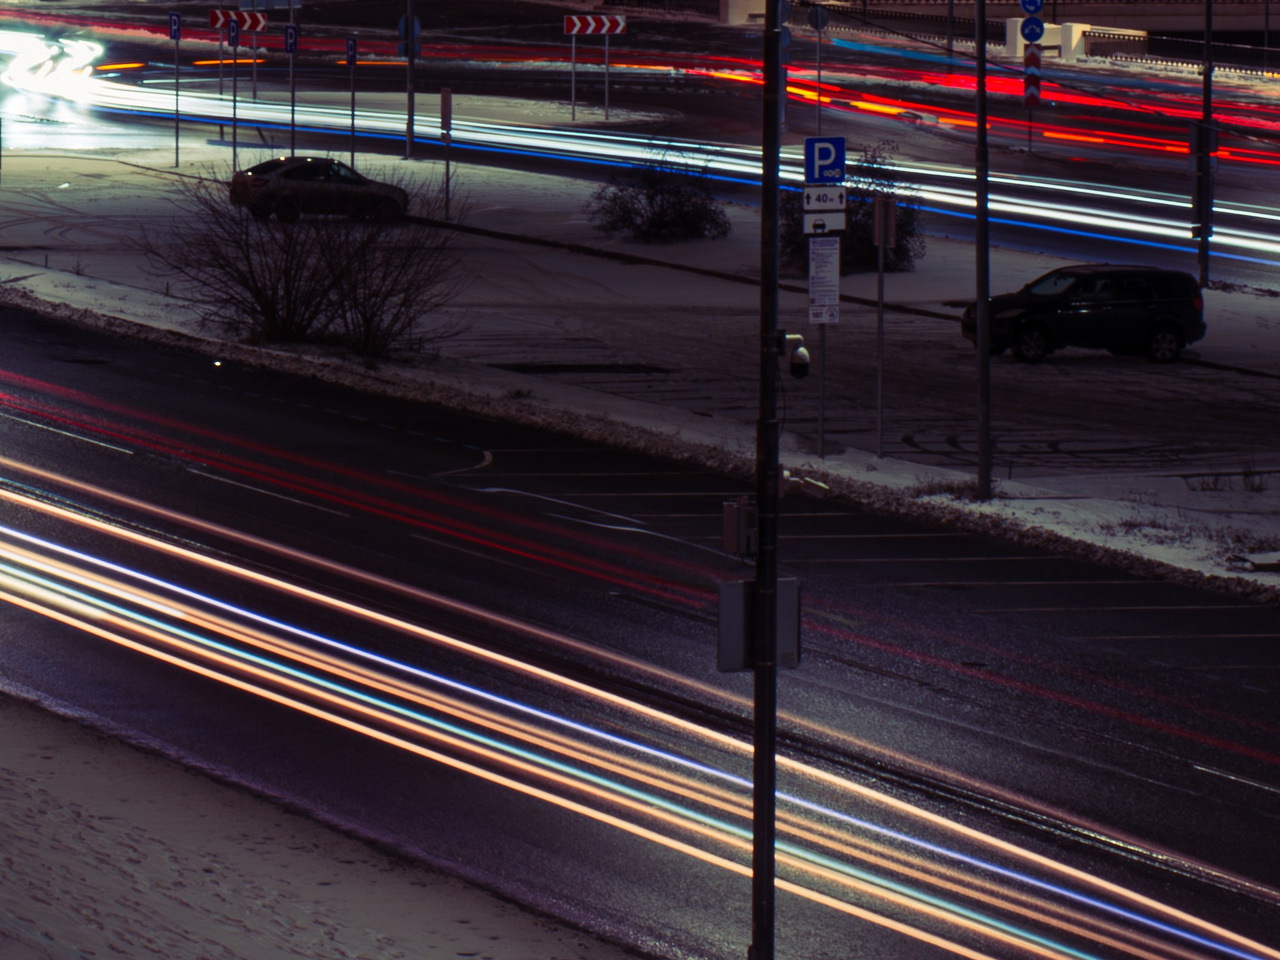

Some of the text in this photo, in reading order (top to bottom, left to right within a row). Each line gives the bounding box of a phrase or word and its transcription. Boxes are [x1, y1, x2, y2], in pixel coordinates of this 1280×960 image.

[171, 15, 179, 37] P
[230, 22, 237, 43] P
[287, 28, 295, 50] P
[348, 40, 355, 61] P
[814, 142, 837, 180] P
